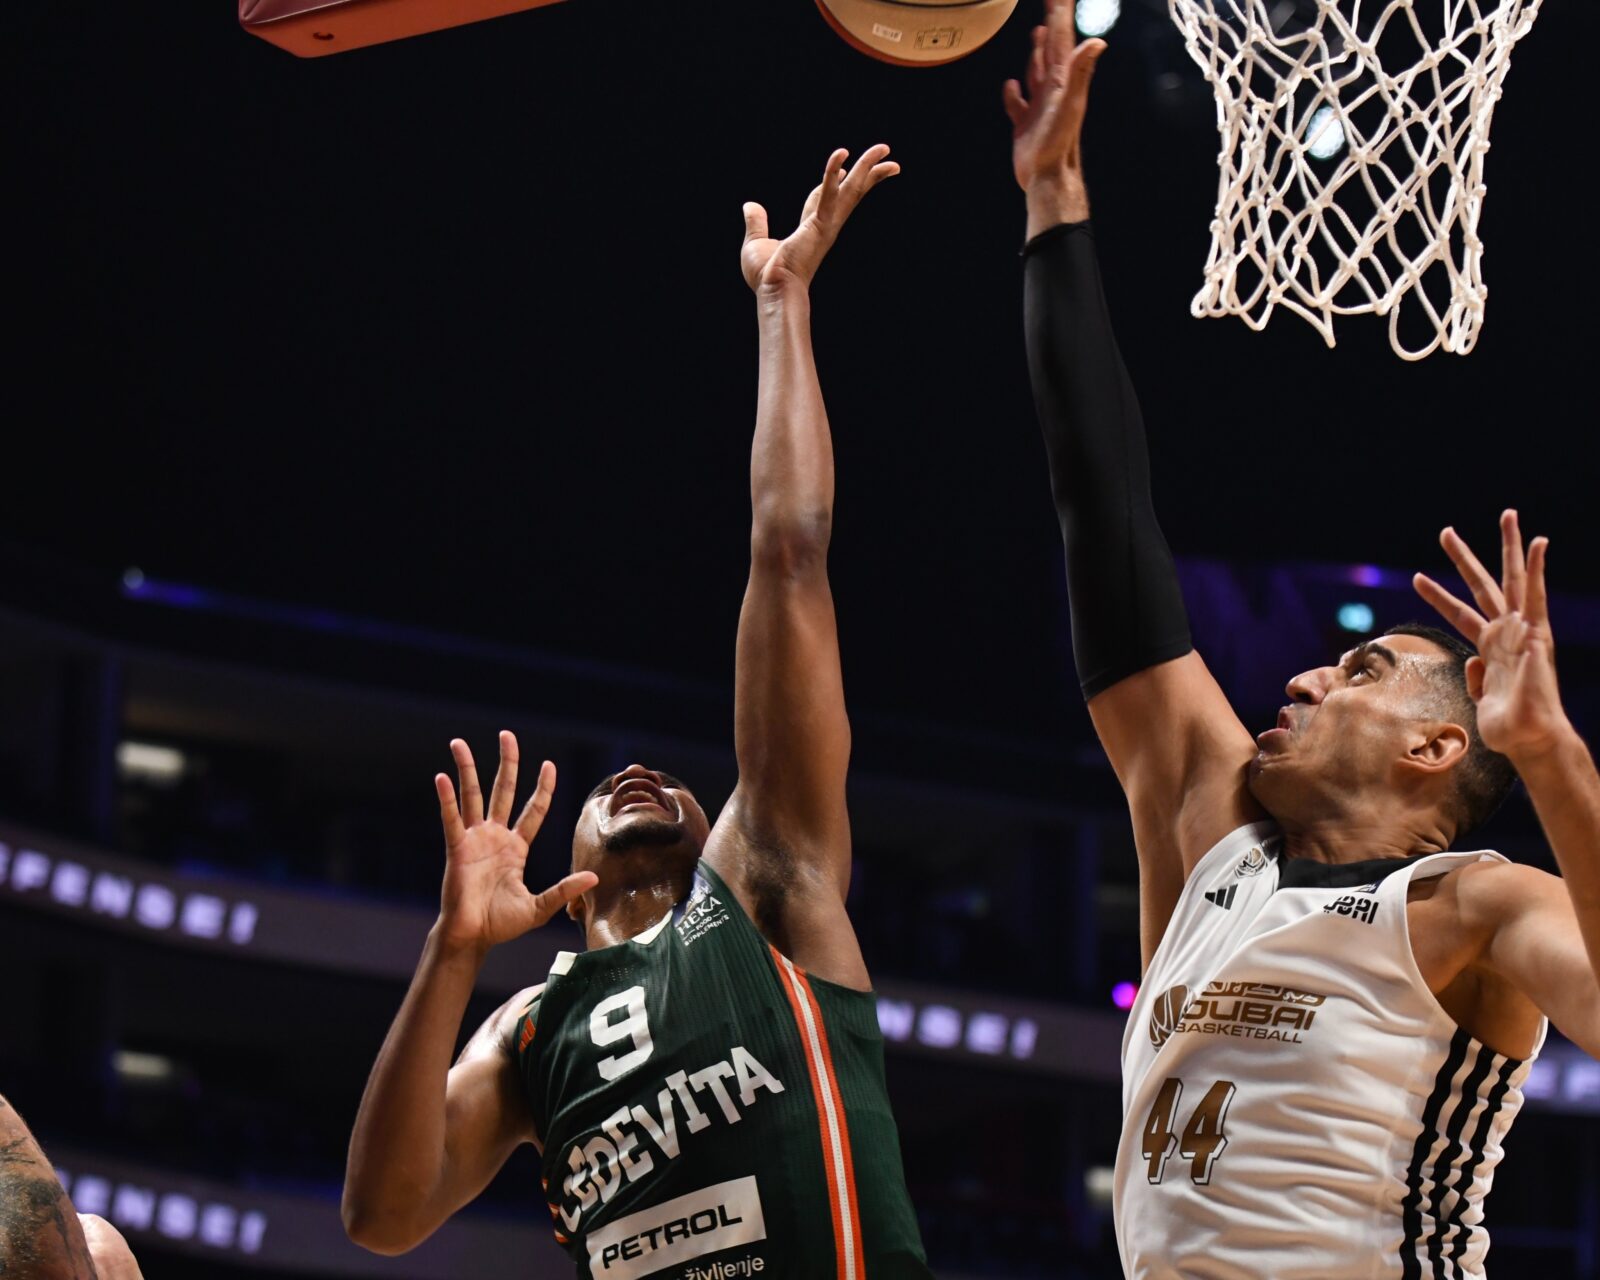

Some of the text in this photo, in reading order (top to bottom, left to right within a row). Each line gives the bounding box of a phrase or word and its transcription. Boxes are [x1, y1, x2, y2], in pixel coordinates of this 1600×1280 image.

[677, 896, 722, 935] HEKA
[684, 914, 730, 946] SUPPLEMENTS
[696, 916, 712, 931] FOOD
[589, 985, 654, 1081] 9
[1175, 1022, 1303, 1044] BASKETBALL
[1142, 1077, 1237, 1185] 44
[602, 1205, 743, 1269] PETROL
[684, 1254, 765, 1280] življenje
